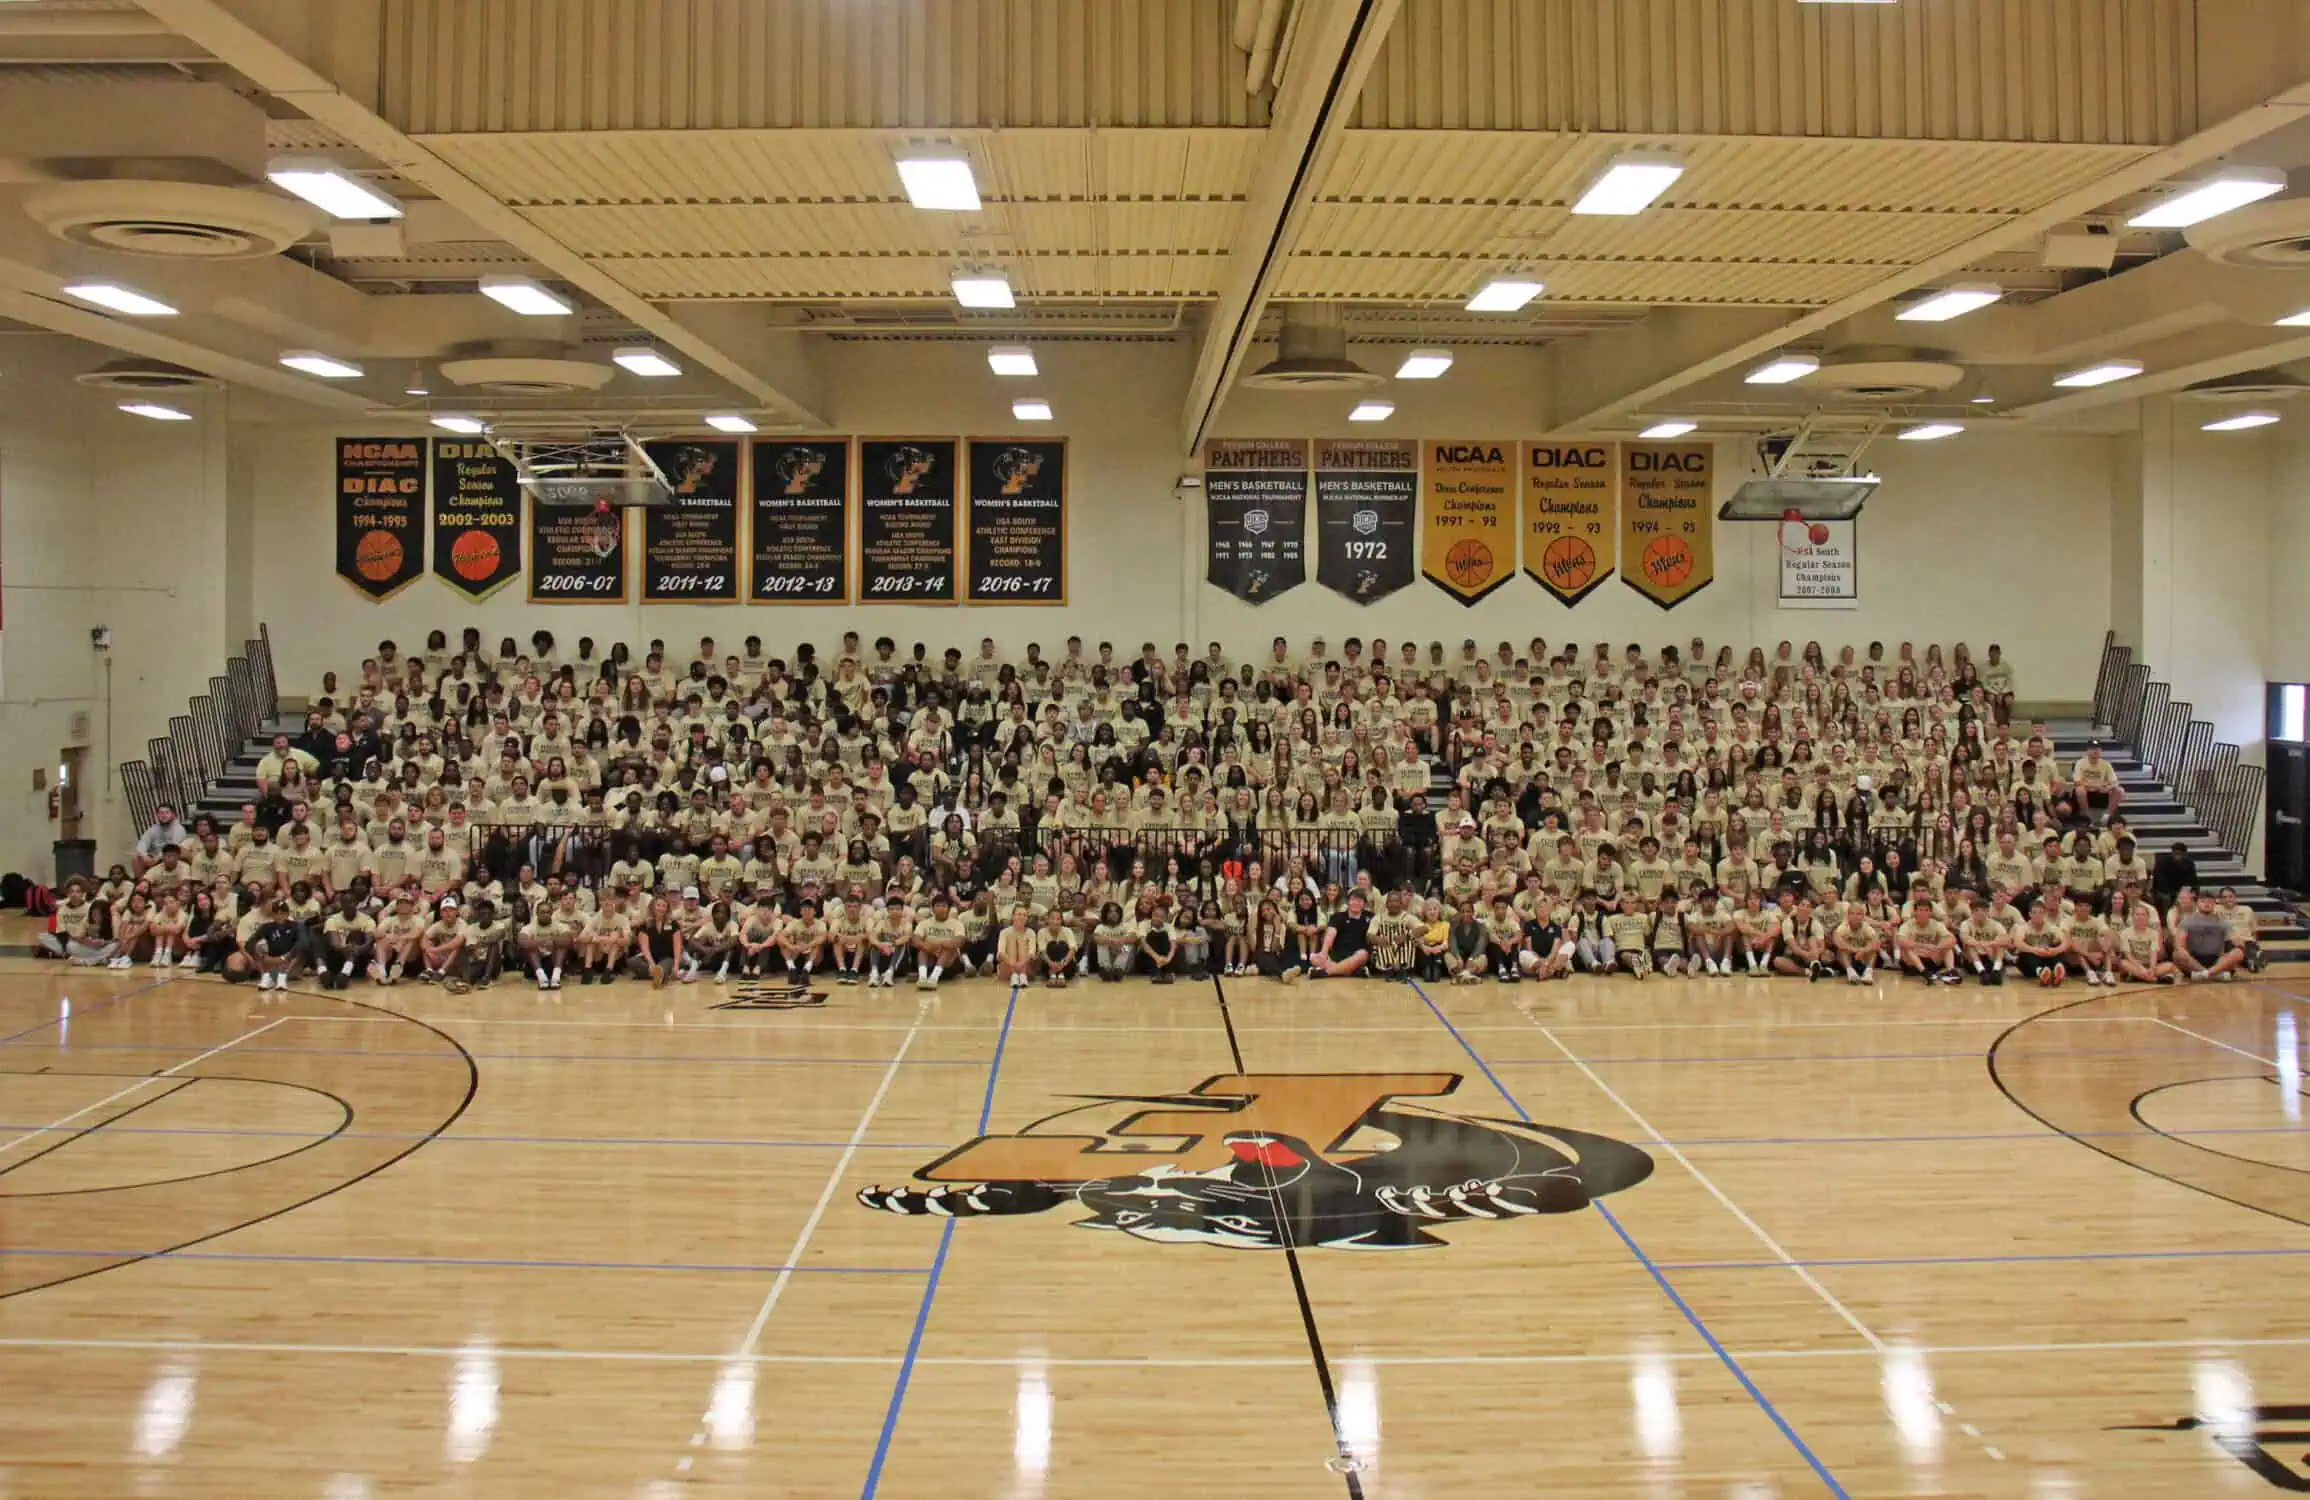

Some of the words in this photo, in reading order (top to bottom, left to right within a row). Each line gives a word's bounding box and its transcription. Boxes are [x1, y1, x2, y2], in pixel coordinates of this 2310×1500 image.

[343, 444, 418, 459] NCAA
[439, 444, 500, 459] DIA
[1211, 450, 1302, 467] PANTHERS
[1436, 446, 1504, 464] NCAA
[1532, 448, 1606, 468] DIAC
[1320, 451, 1412, 468] PANTHERS
[1630, 452, 1705, 472] DIAC
[343, 478, 419, 493] DIAC
[1209, 481, 1240, 490] MEN'S
[1241, 481, 1304, 490] BASKETBALL
[1319, 481, 1349, 491] MEN'S
[1351, 481, 1412, 491] BASKETBALL
[1531, 476, 1569, 491] Regular
[1573, 477, 1606, 489] Season
[866, 499, 903, 507] WOMEN'S
[905, 499, 950, 507] BASKETBALL
[974, 499, 1011, 507] WOMEN'S
[1012, 499, 1059, 507] BASKETBALL
[1539, 496, 1598, 518] Champions
[1638, 493, 1697, 512] Champions
[438, 513, 514, 526] 2002-2003
[1436, 516, 1462, 527] 1991
[1344, 541, 1388, 559] 1972
[1786, 560, 1819, 571] Regular
[1822, 560, 1852, 569] Season
[539, 575, 617, 591] 2006-07
[656, 576, 726, 591] 2011-12
[761, 576, 836, 592] 2012-13
[870, 576, 945, 592] 2013-14
[977, 576, 1053, 592] 2016-17
[1796, 573, 1841, 583] Champions
